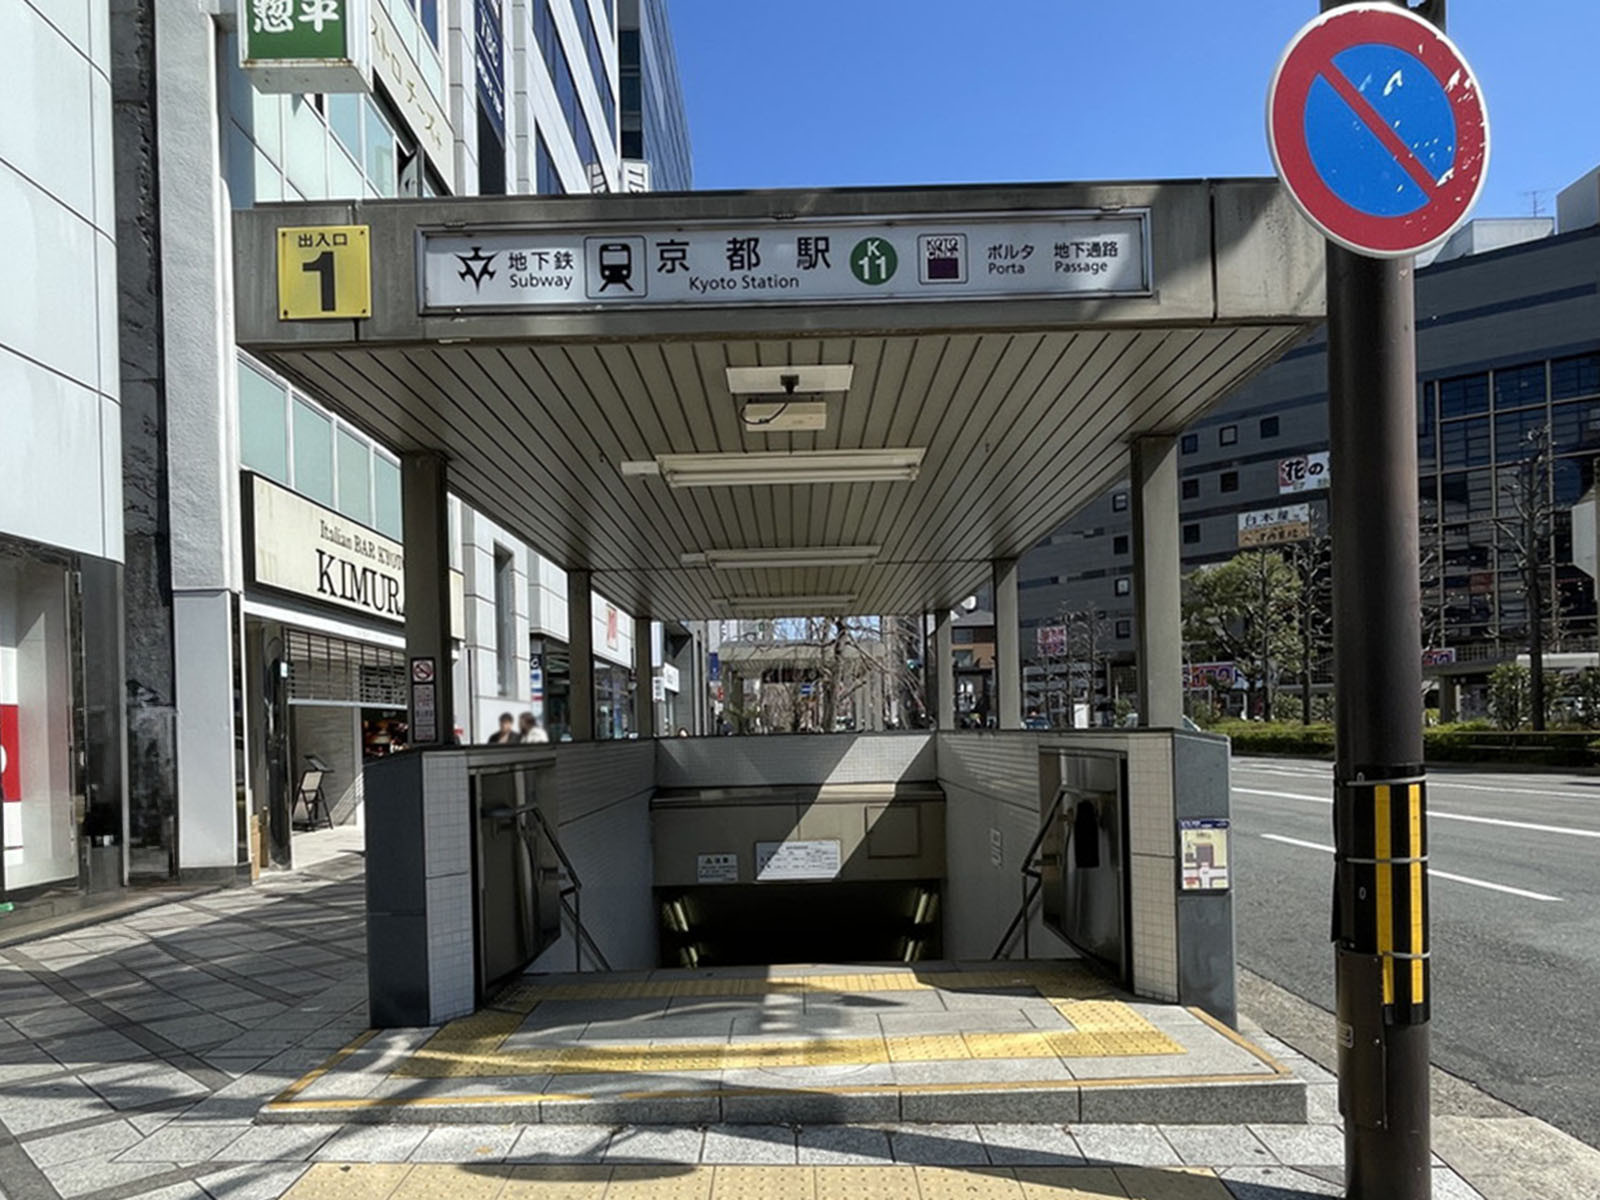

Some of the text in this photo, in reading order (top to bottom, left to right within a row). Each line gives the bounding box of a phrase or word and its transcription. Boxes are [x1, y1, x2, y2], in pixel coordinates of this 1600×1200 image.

[298, 233, 347, 248] 出入口
[866, 241, 881, 256] K
[1054, 240, 1118, 259] 地下通路
[508, 251, 574, 271] 地下鉄
[656, 236, 831, 274] 京都駅
[857, 258, 889, 280] 11
[988, 262, 1025, 275] Porta
[1055, 260, 1108, 274] Passage
[302, 250, 336, 312] 1
[510, 273, 573, 290] Subway
[689, 273, 799, 292] Kyoto Station
[1286, 459, 1324, 480] 花の
[315, 548, 406, 616] KIMUR
